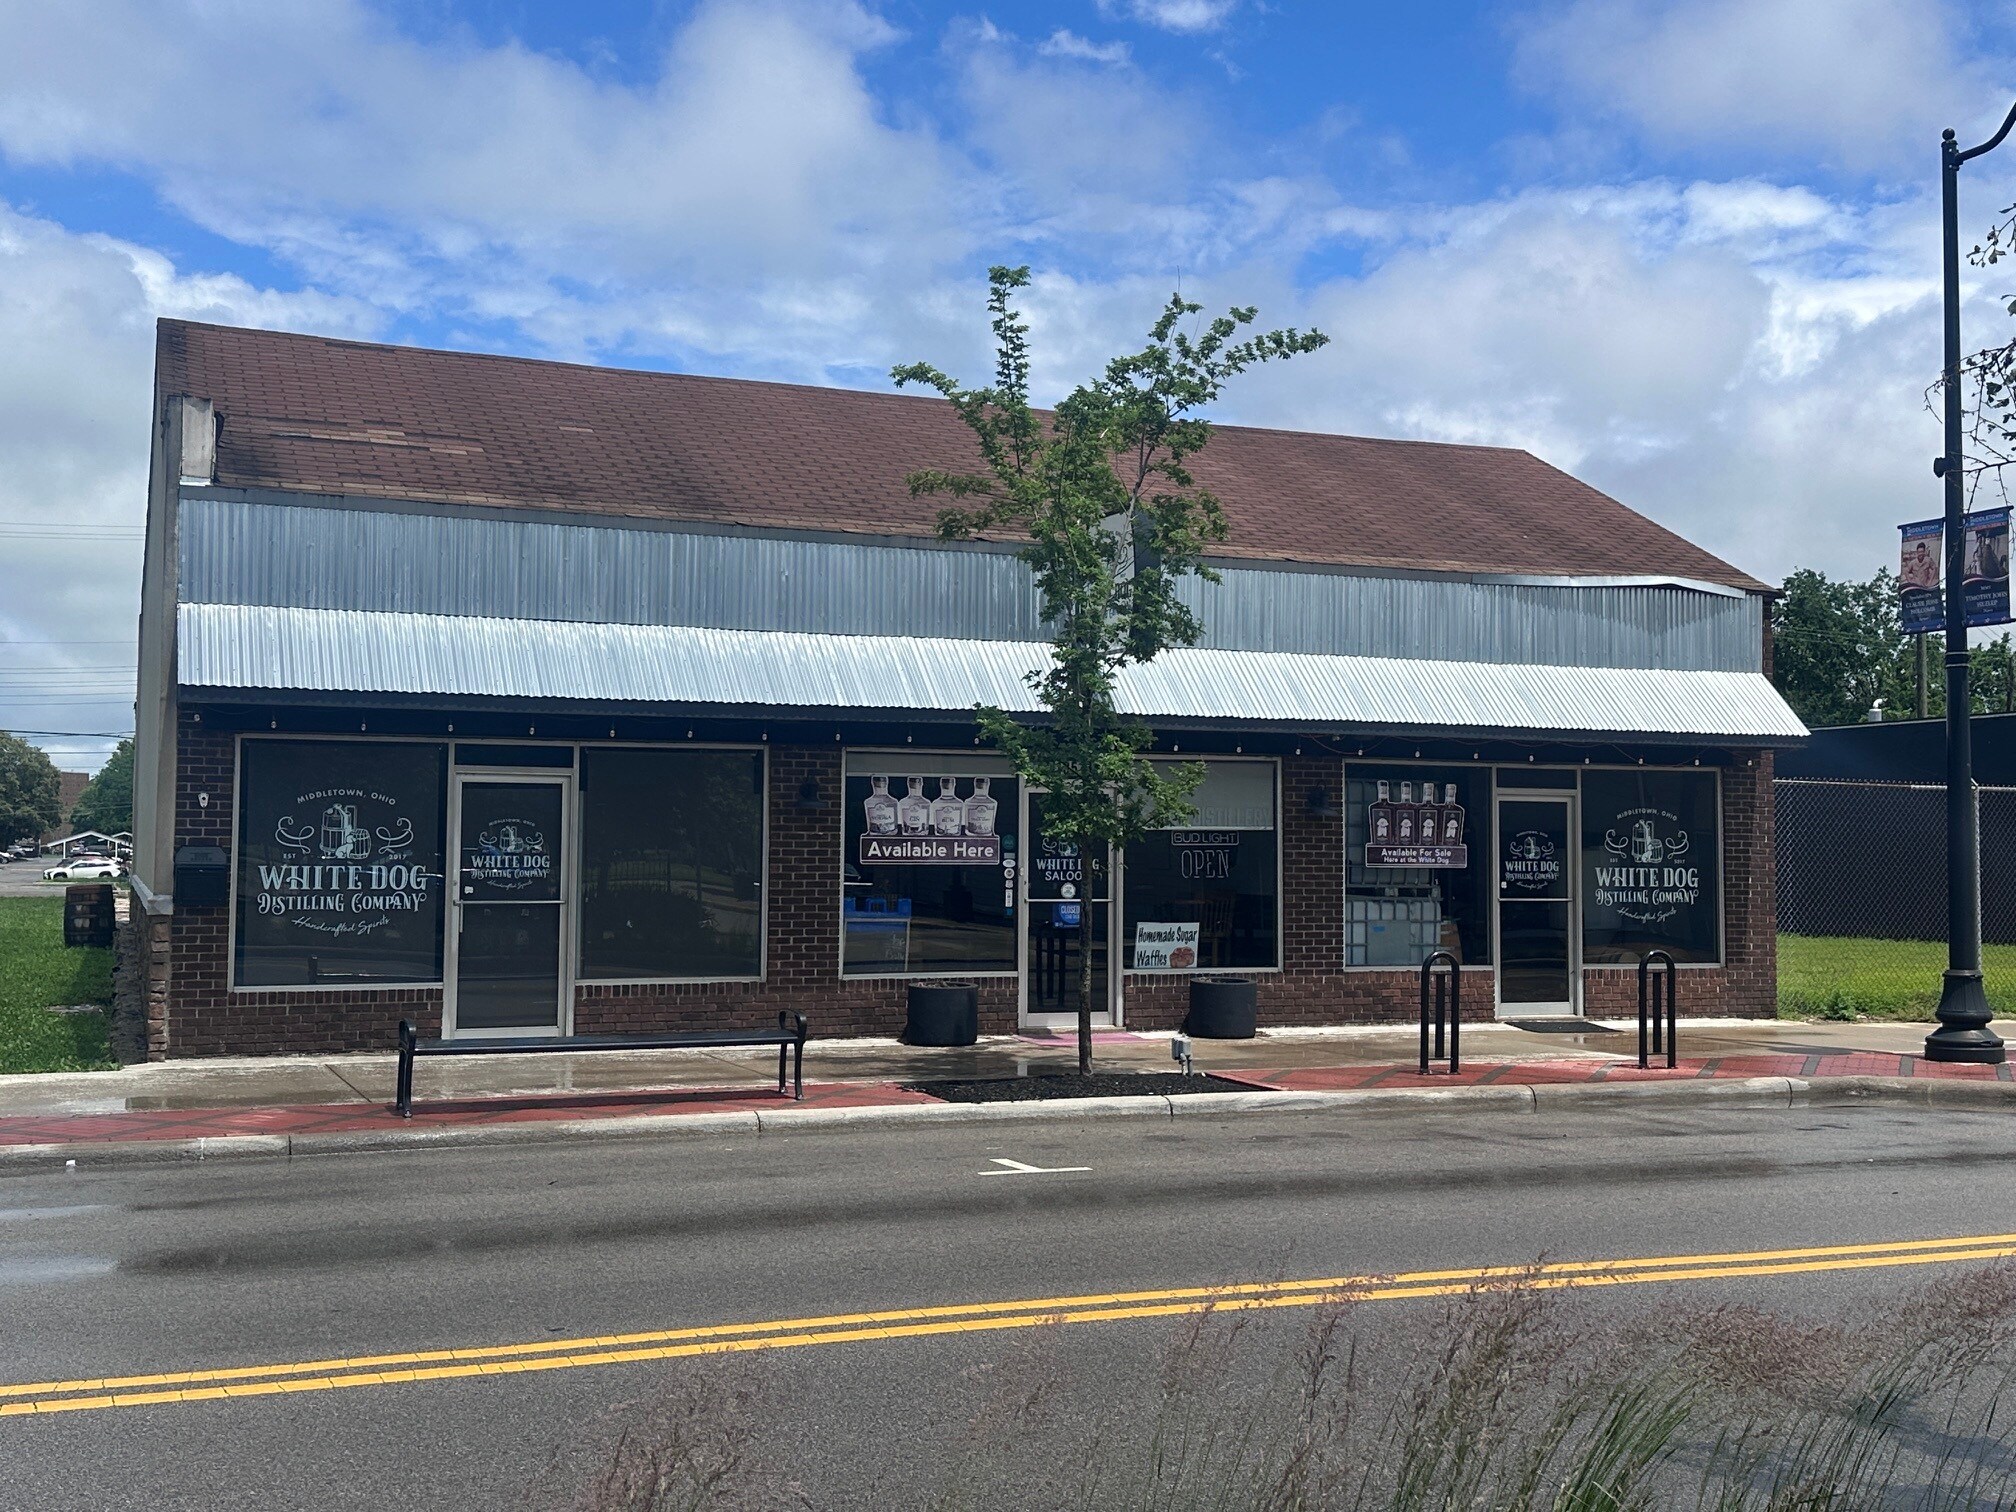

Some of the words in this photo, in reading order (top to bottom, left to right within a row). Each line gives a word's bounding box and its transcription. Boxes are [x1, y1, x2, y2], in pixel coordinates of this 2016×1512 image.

[297, 789, 366, 804] MIDDLETOWN,
[370, 792, 396, 806] OHIO
[1662, 810, 1678, 821] OHIO
[1174, 832, 1200, 843] BUD
[1202, 832, 1236, 843] LIGHT
[868, 842, 947, 857] Available
[954, 842, 994, 857] Here
[471, 855, 520, 868] WHITE
[523, 855, 551, 868] DOG
[1036, 859, 1077, 870] WHITE
[1181, 850, 1230, 878] OPEN
[1505, 861, 1539, 872] WHITE
[1540, 861, 1560, 872] DOG
[258, 865, 362, 890] WHITE
[370, 865, 428, 890] DOG
[514, 868, 550, 879] COMPANY
[1045, 871, 1083, 881] SALOO
[1595, 867, 1659, 888] WHITE
[1663, 867, 1699, 888] DOG
[258, 893, 344, 916] DISTILLING
[351, 891, 427, 913] COMPANY
[1595, 888, 1649, 906] DISTILLING
[1652, 888, 1699, 905] COMPANY
[1138, 927, 1175, 944] Homemade
[1176, 926, 1198, 945] Sugar
[1136, 950, 1167, 967] Waffles
